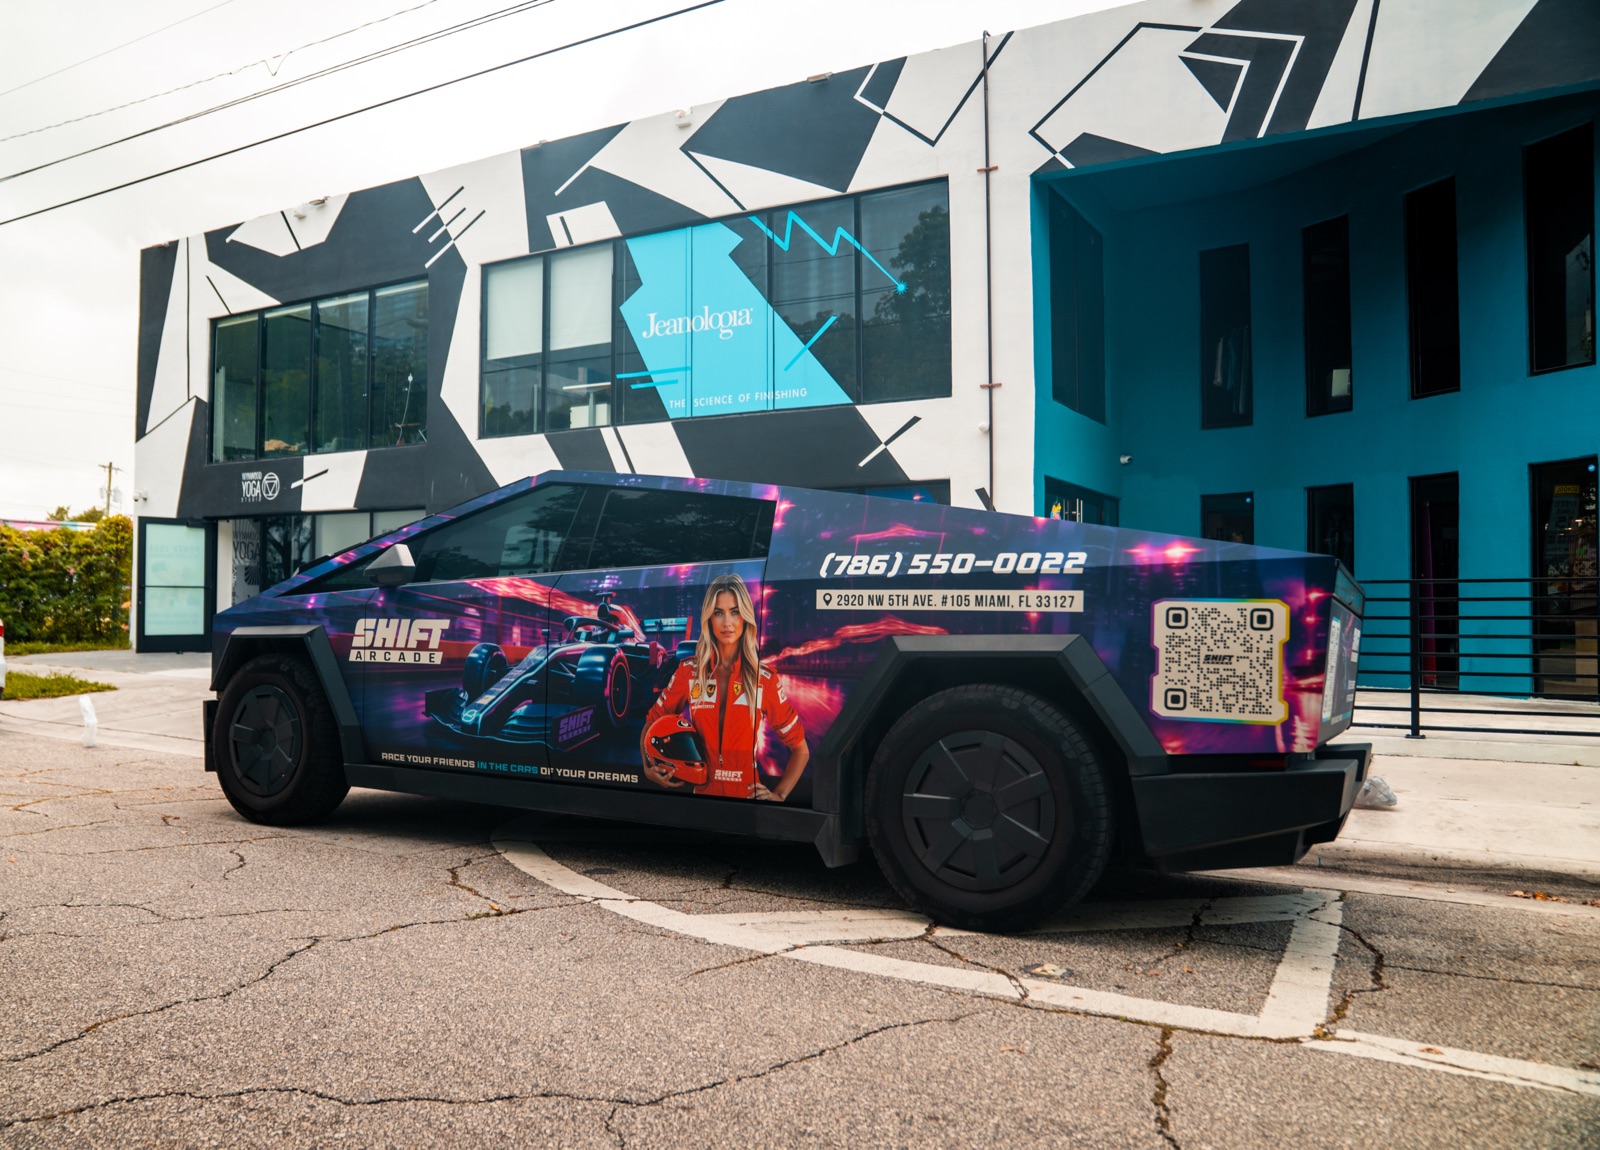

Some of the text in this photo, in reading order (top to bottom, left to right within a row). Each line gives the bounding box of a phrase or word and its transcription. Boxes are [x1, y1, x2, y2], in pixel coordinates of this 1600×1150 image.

[642, 305, 752, 340] Jeanologia
[669, 387, 807, 408] THE SCIENCE OF FINISHING
[241, 480, 261, 498] YOGA
[233, 541, 260, 560] YOGA
[819, 552, 1087, 578] (786) 550-0022
[837, 594, 1075, 608] 2920 NW 5TH AVE. #105 MIAMI, FL 33127
[352, 618, 450, 649] SHIFT
[355, 651, 435, 663] ARCADE
[1203, 654, 1234, 662] SHIFT
[559, 709, 593, 735] SHIFT
[381, 752, 638, 783] RACE YOUR FRIENDS IN THE CARS OF YOUR DREAMS
[715, 769, 743, 778] SHIFT
